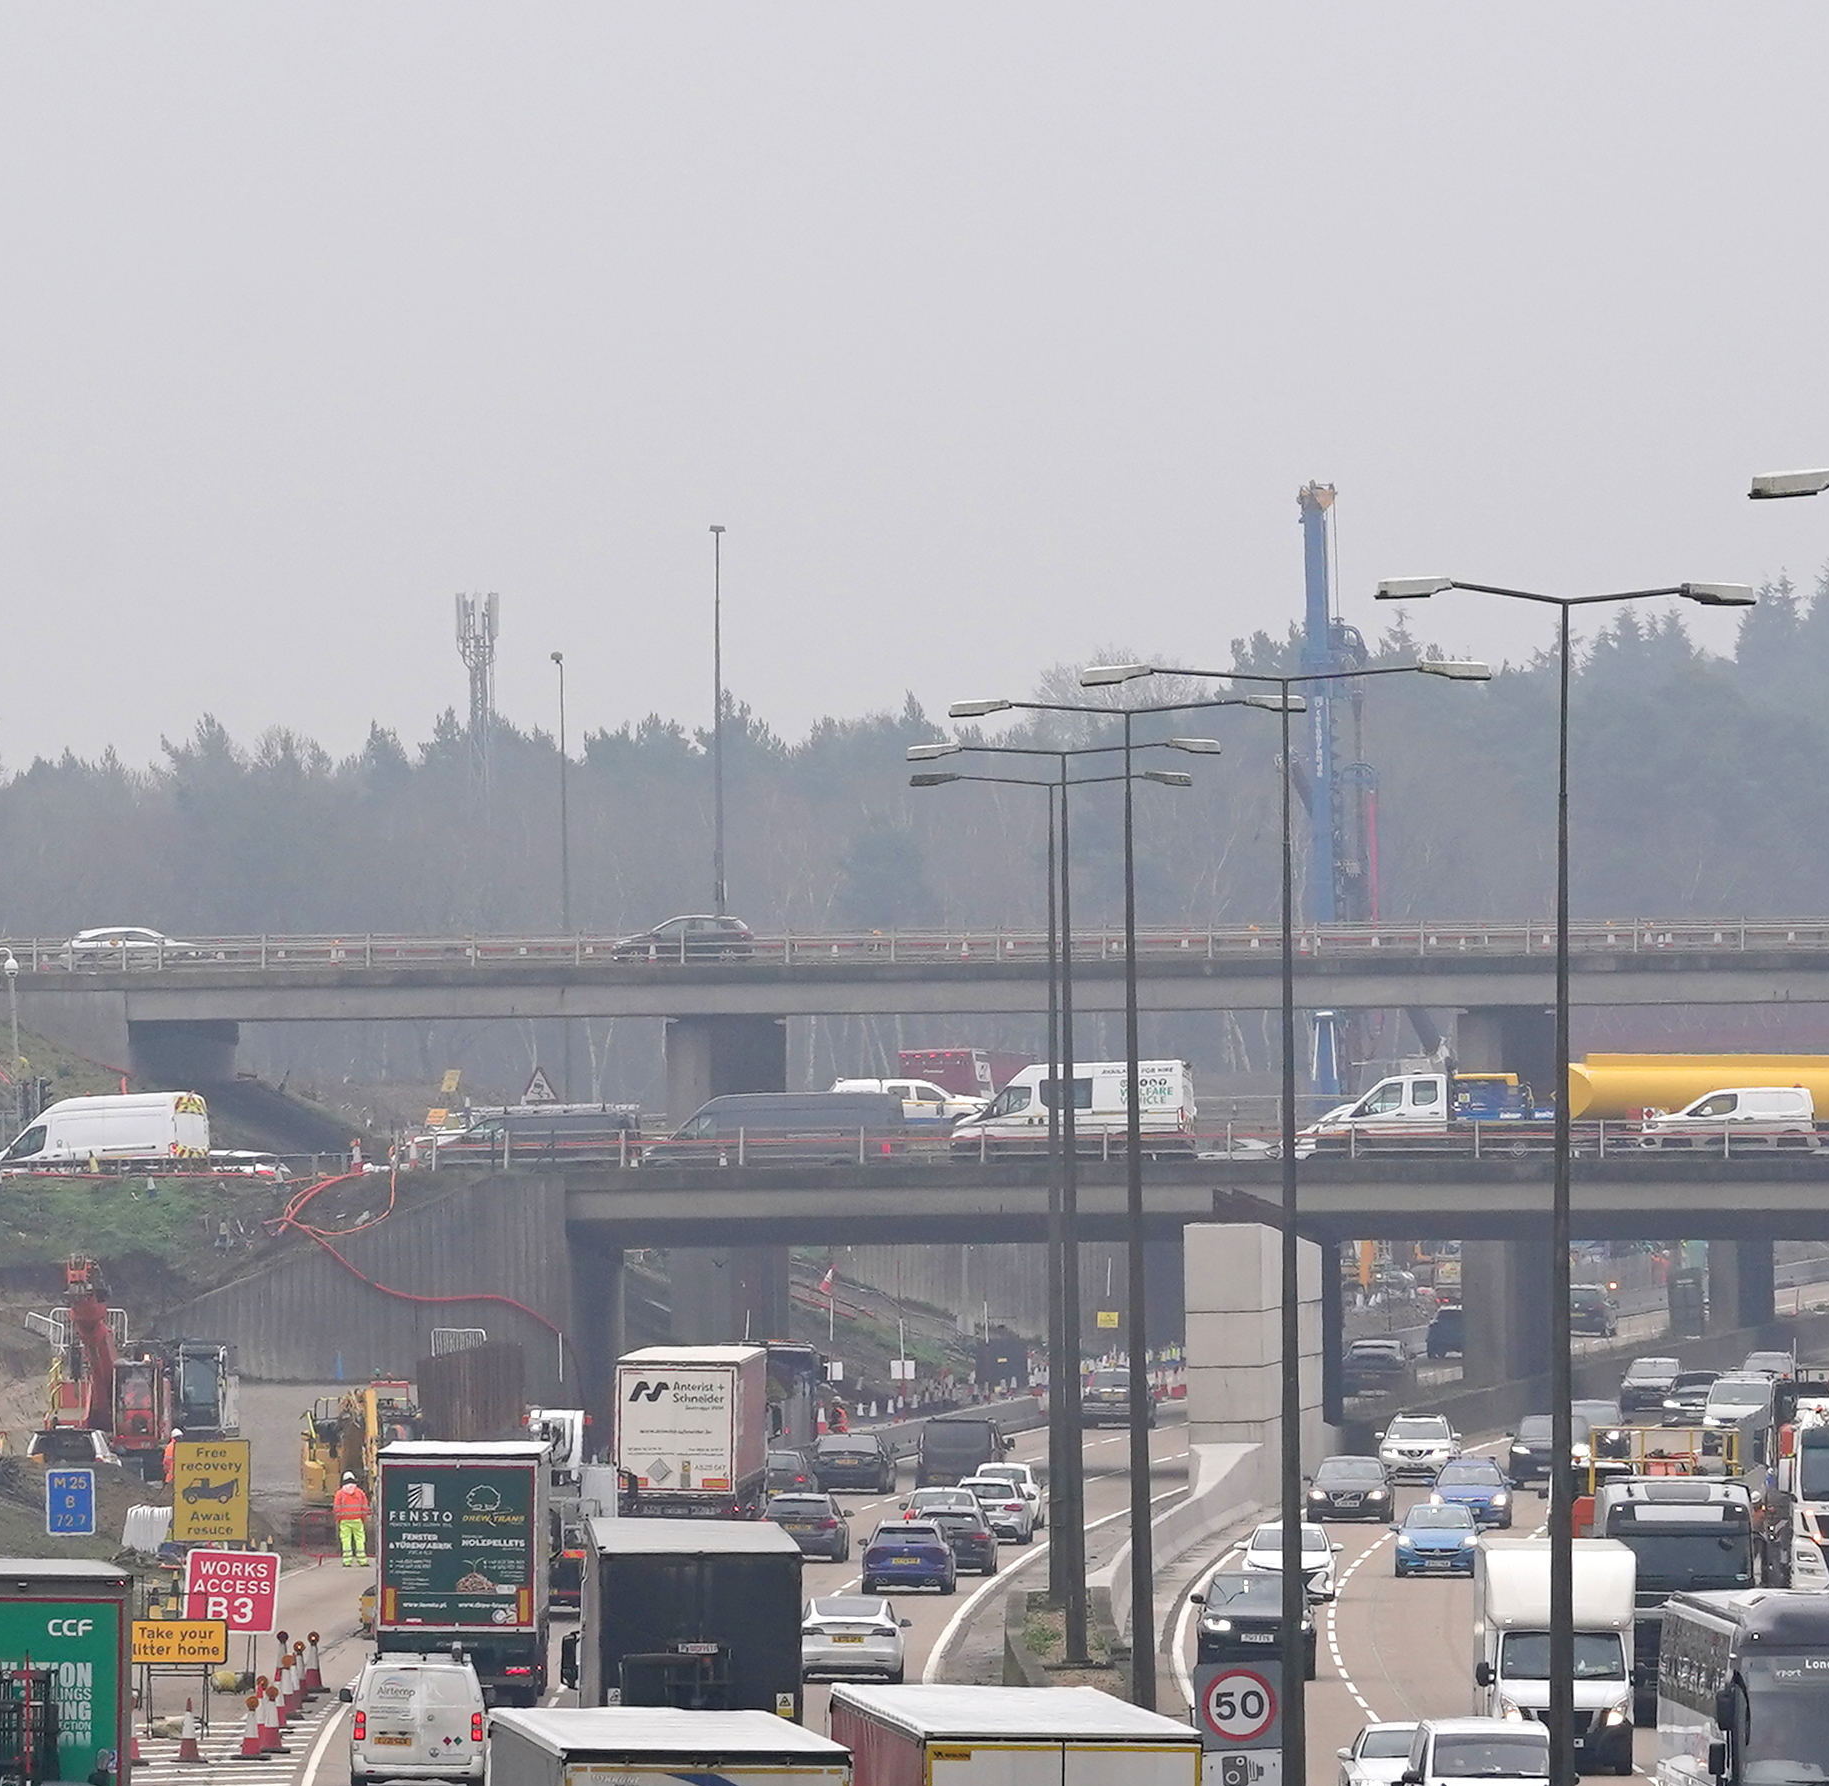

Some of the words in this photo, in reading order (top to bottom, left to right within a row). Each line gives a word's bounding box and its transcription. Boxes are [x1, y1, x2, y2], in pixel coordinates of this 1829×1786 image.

[1120, 1086, 1174, 1096] WLFARE
[672, 1382, 714, 1392] Anterist
[672, 1393, 725, 1404] Schneider
[196, 1448, 227, 1458] Free
[180, 1462, 242, 1473] recovery
[190, 1511, 230, 1522] Await
[389, 1511, 453, 1522] FENSTO
[200, 1561, 268, 1578] WORKS
[193, 1579, 271, 1594] ACCESS
[207, 1597, 254, 1624] B3
[47, 1619, 94, 1637] CCF
[138, 1627, 174, 1640] Take
[180, 1629, 214, 1642] your
[133, 1644, 172, 1655] litter
[178, 1644, 220, 1656] home
[377, 1686, 416, 1698] Airtemp
[1216, 1690, 1264, 1720] 50
